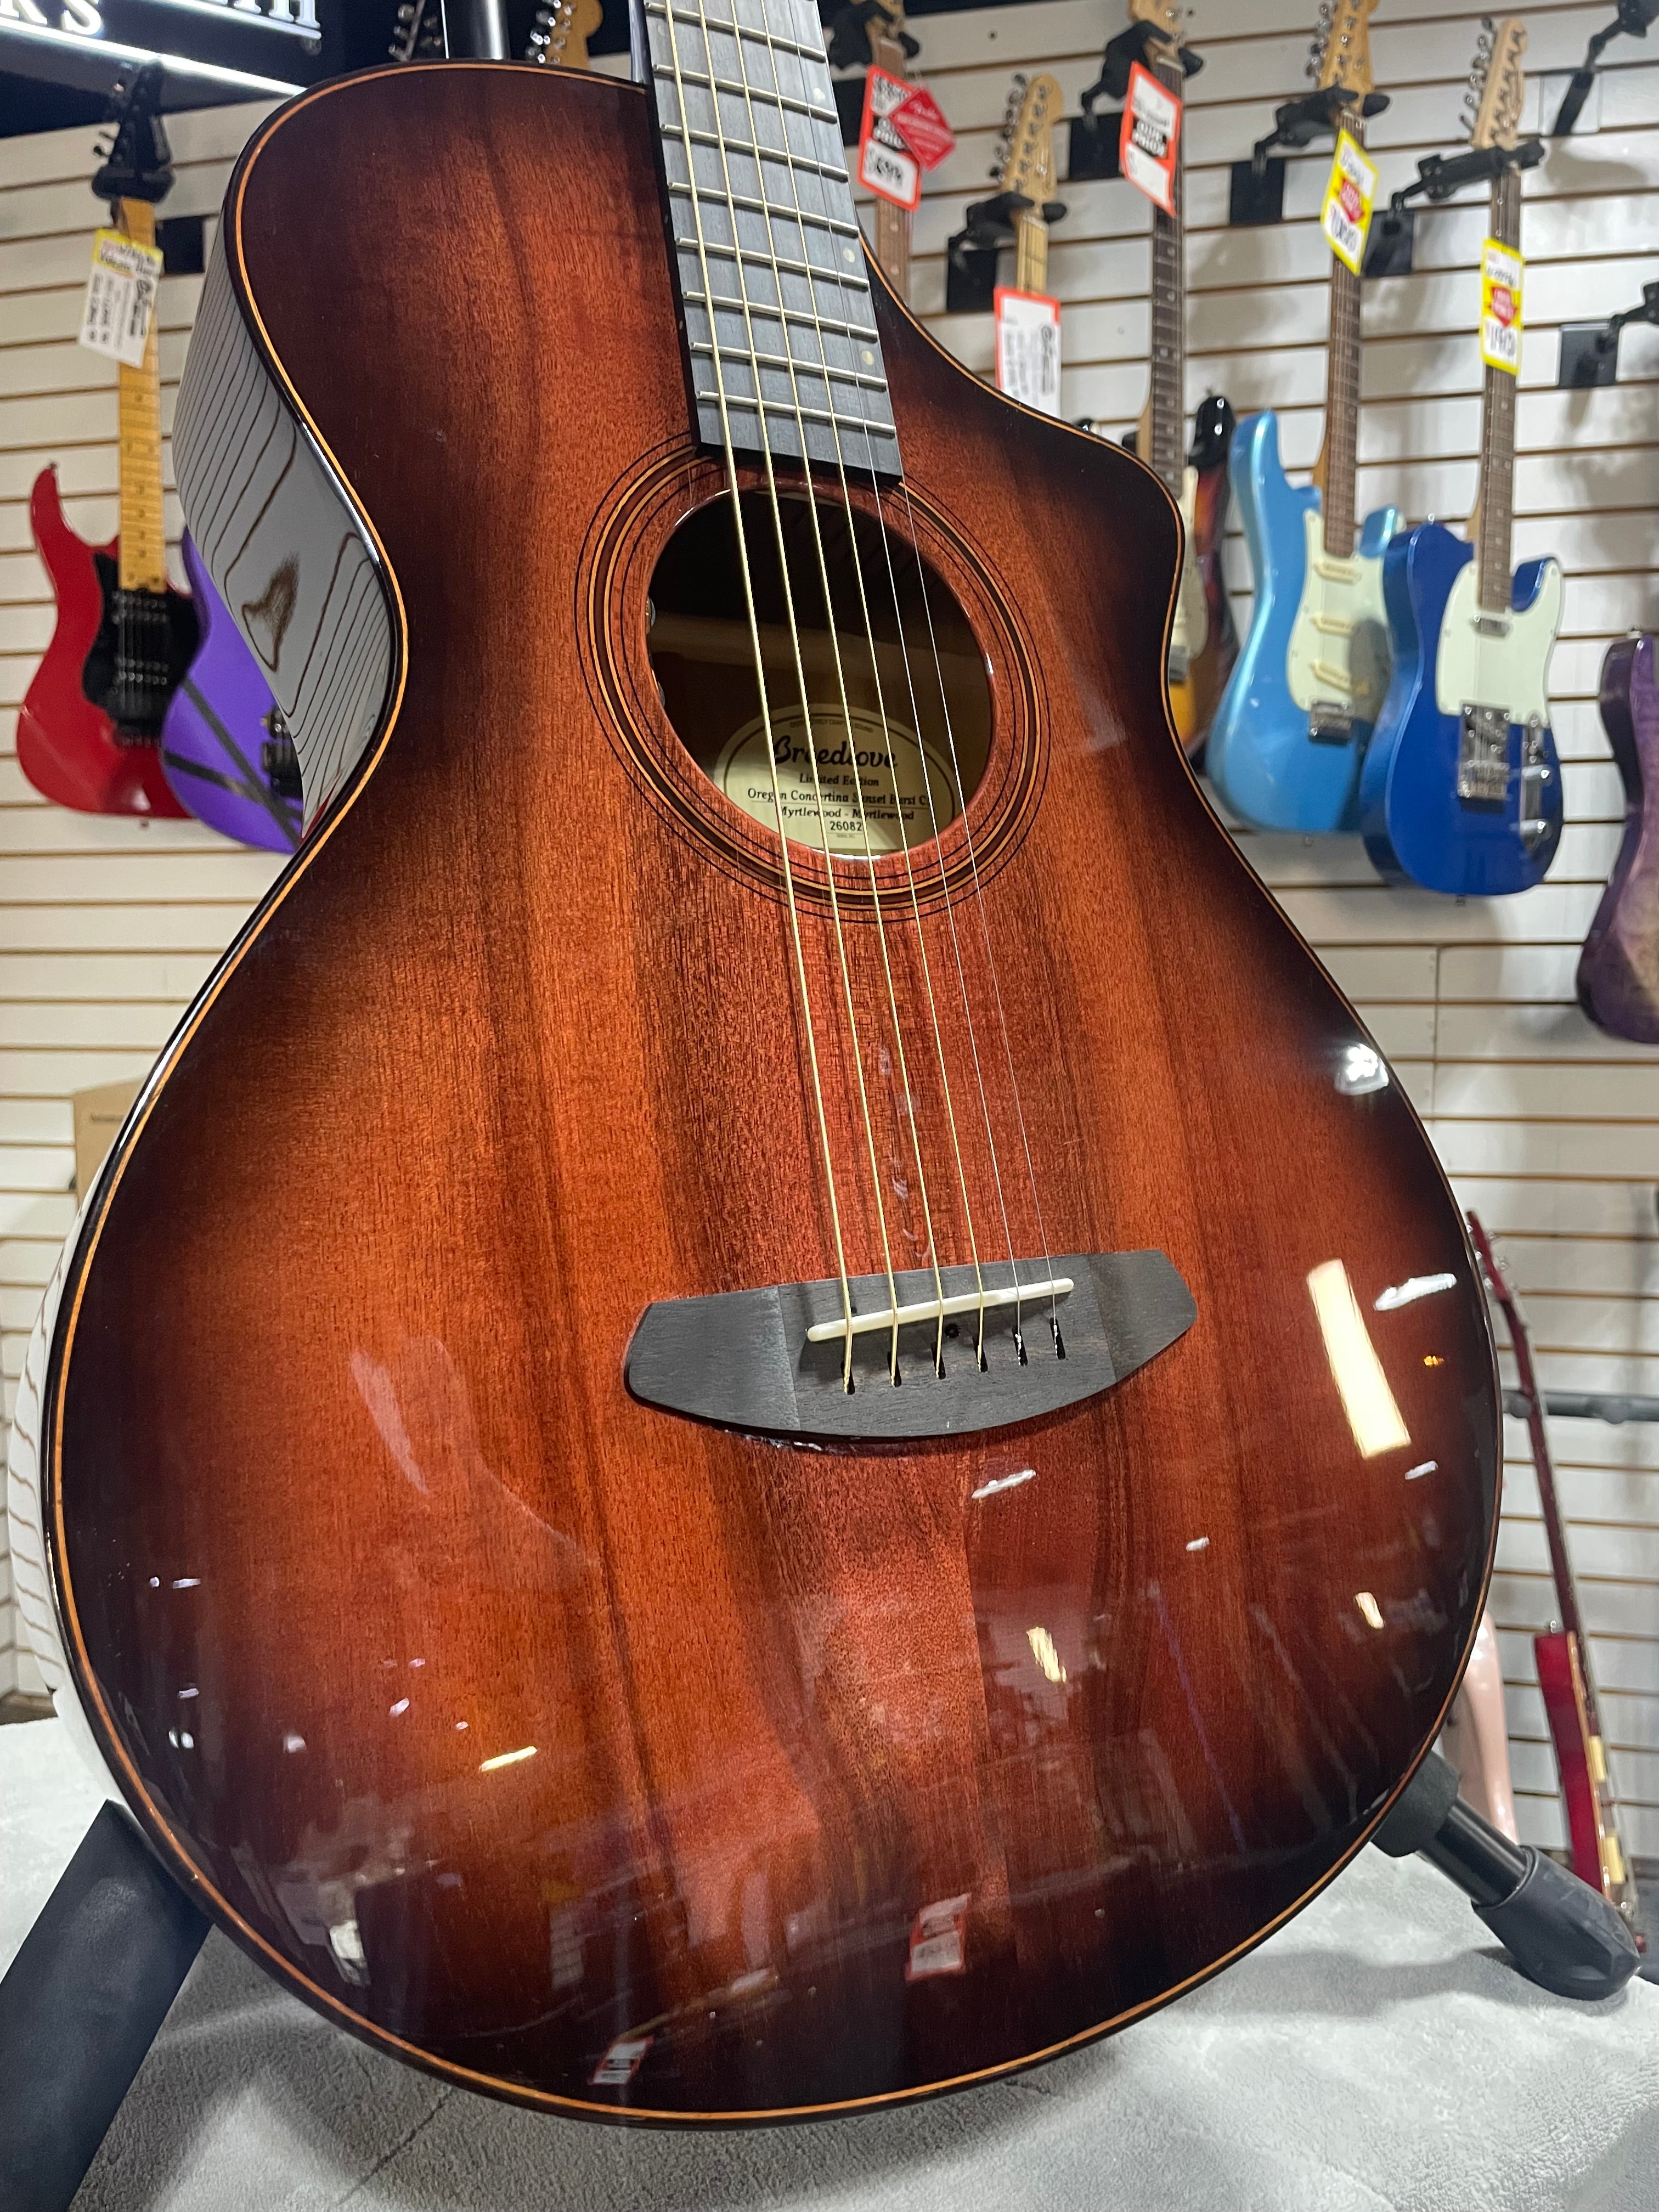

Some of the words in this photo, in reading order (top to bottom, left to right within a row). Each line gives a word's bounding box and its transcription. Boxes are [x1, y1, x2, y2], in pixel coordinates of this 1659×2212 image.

[843, 775, 879, 787] Edtion
[748, 788, 787, 803] Oregn
[791, 790, 849, 803] Concrtina
[830, 820, 863, 832] 26082
